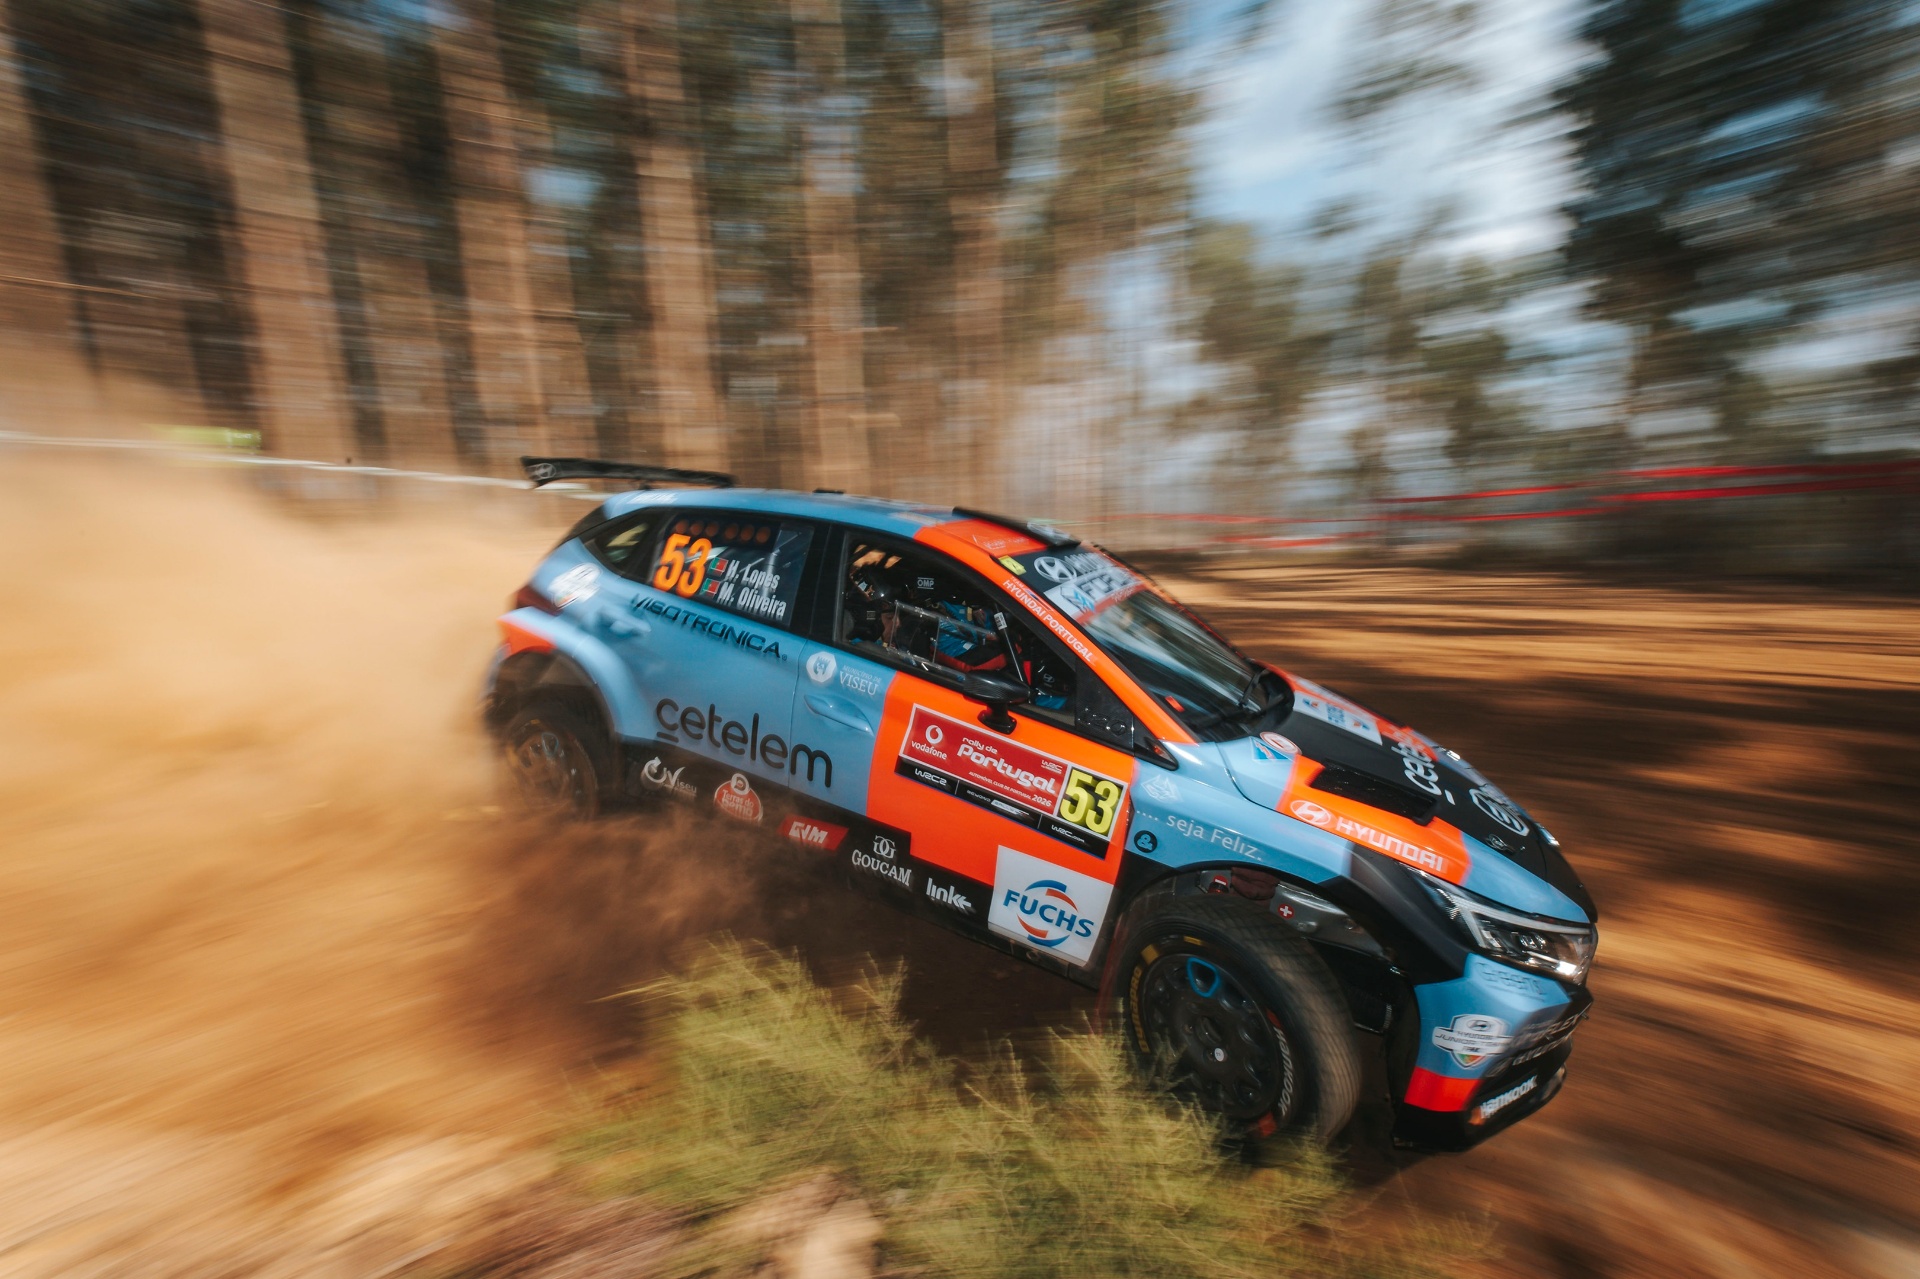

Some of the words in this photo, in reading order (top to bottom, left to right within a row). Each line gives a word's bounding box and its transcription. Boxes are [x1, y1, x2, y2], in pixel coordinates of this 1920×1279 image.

[653, 533, 713, 597] 53
[725, 559, 740, 580] H.
[741, 564, 780, 589] Lopes
[718, 582, 735, 602] M.
[737, 587, 787, 617] Oliveira
[917, 579, 935, 588] OMP
[1003, 580, 1046, 616] HYUNDAI
[1043, 614, 1093, 661] PORTUGAL
[840, 671, 879, 695] VISEU
[656, 698, 832, 788] cetelem
[911, 741, 948, 760] vodafone
[962, 737, 984, 750] rally
[985, 745, 998, 755] de
[957, 744, 1056, 795] Portugal
[1032, 794, 1052, 808] 2026
[1060, 769, 1119, 834] 53
[1166, 814, 1204, 838] seja
[1335, 816, 1443, 871] HYUNDAI
[852, 849, 912, 887] GOUCAM
[1003, 889, 1094, 937] FUCHS
